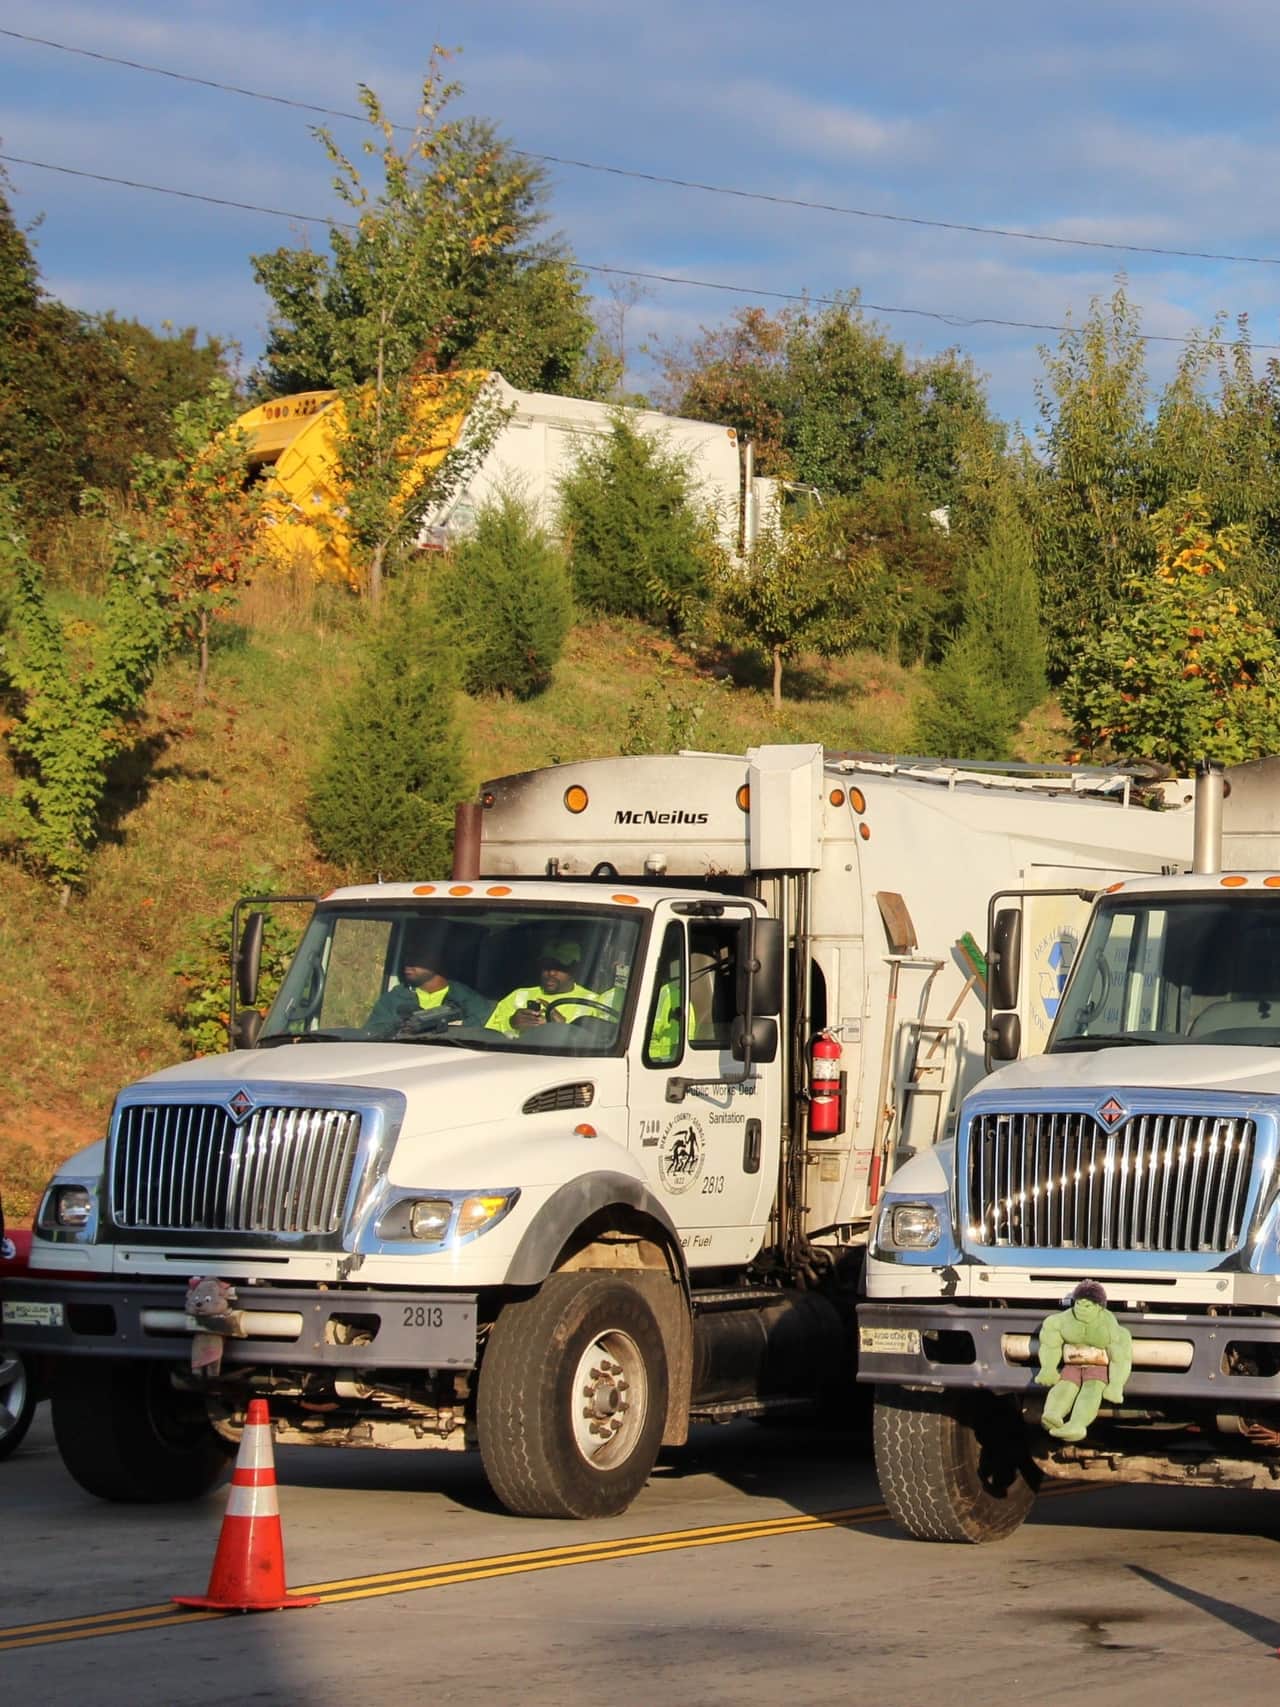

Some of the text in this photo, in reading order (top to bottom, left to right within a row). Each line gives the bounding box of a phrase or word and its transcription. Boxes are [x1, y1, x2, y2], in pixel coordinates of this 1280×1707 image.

[614, 810, 709, 824] McNeilus
[712, 1085, 736, 1096] Works
[708, 1112, 745, 1124] Sanitation
[702, 1176, 724, 1194] 2813
[693, 1235, 712, 1247] Fuel
[403, 1307, 443, 1327] 2813
